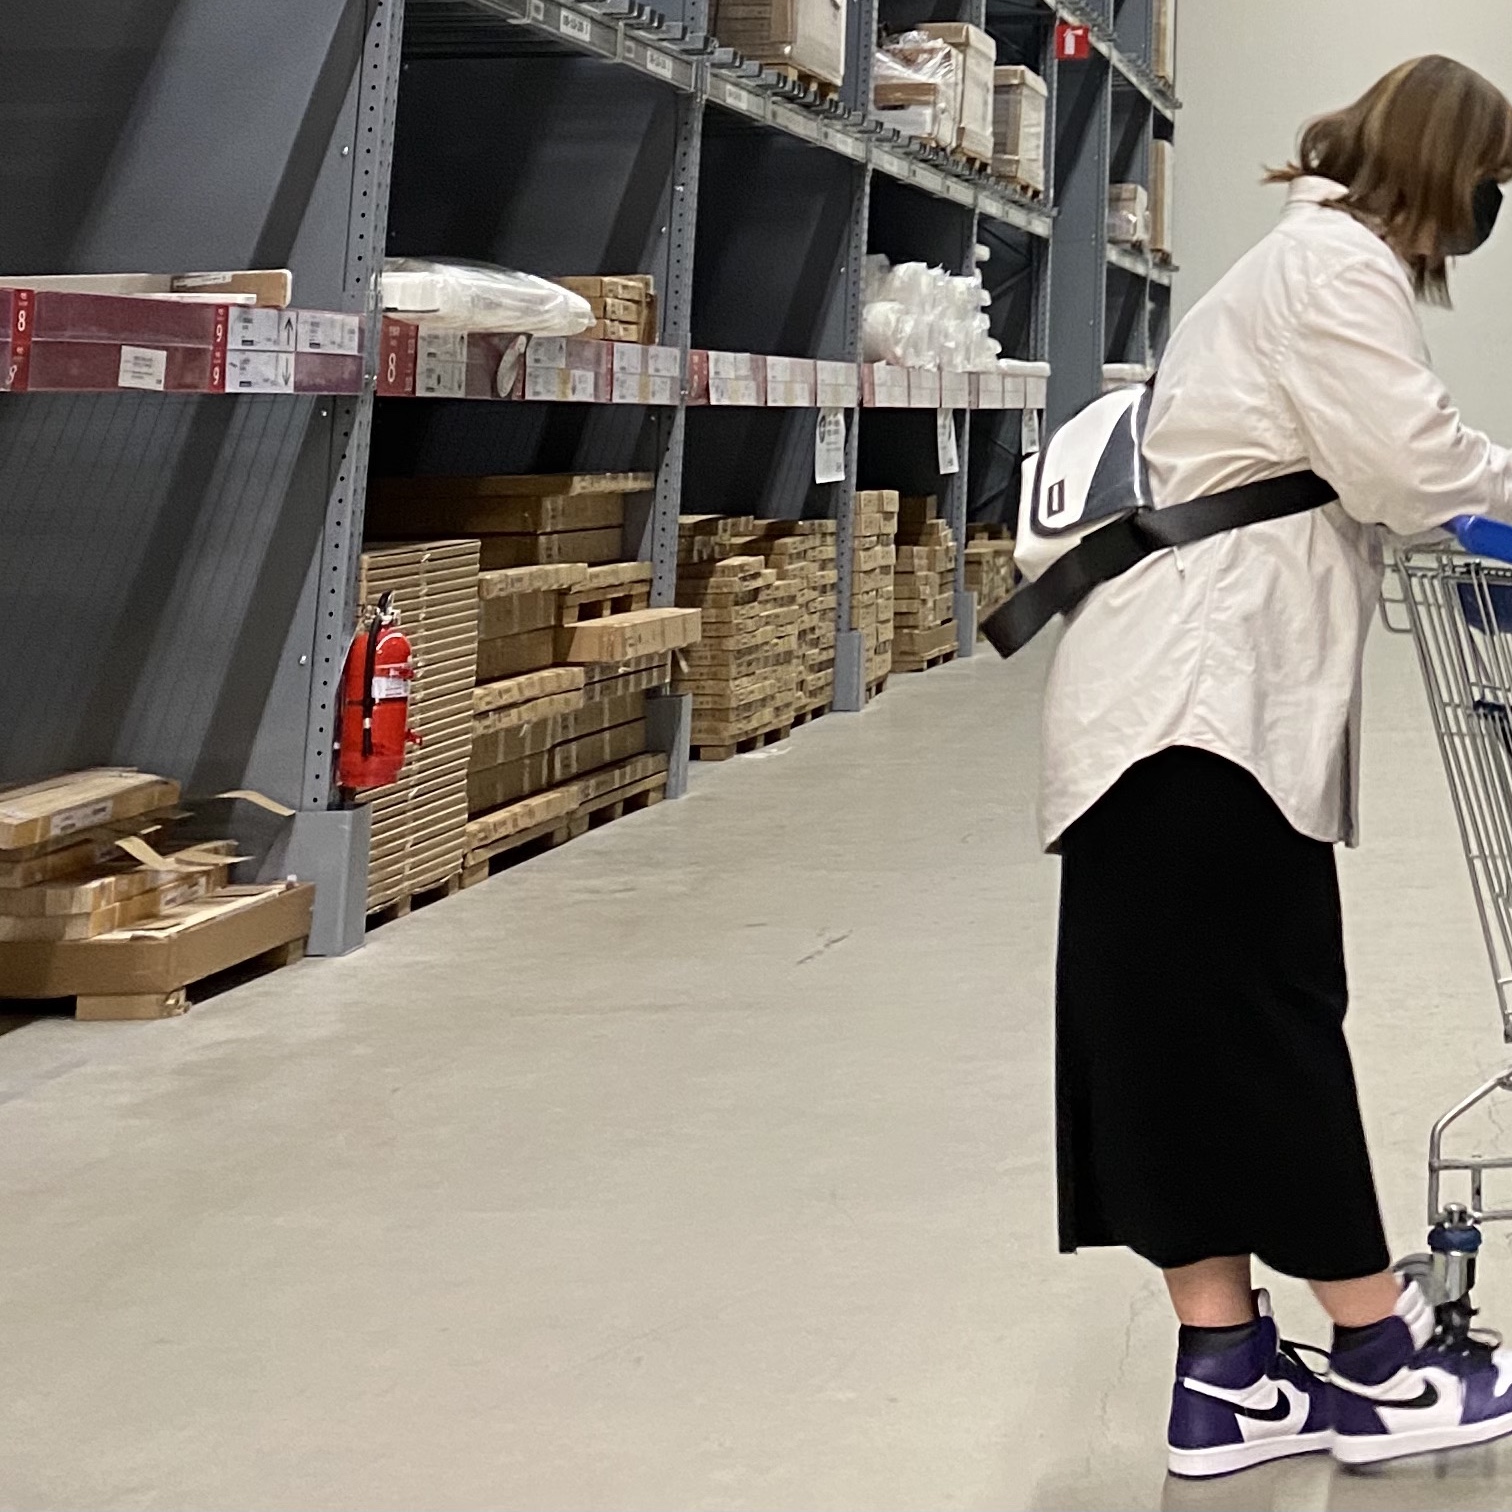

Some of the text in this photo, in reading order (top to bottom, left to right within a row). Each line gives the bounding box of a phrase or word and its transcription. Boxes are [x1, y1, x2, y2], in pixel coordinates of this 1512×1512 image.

[17, 309, 26, 332] 8
[216, 324, 223, 343] 9
[213, 366, 220, 385] 9
[387, 352, 397, 384] 8
